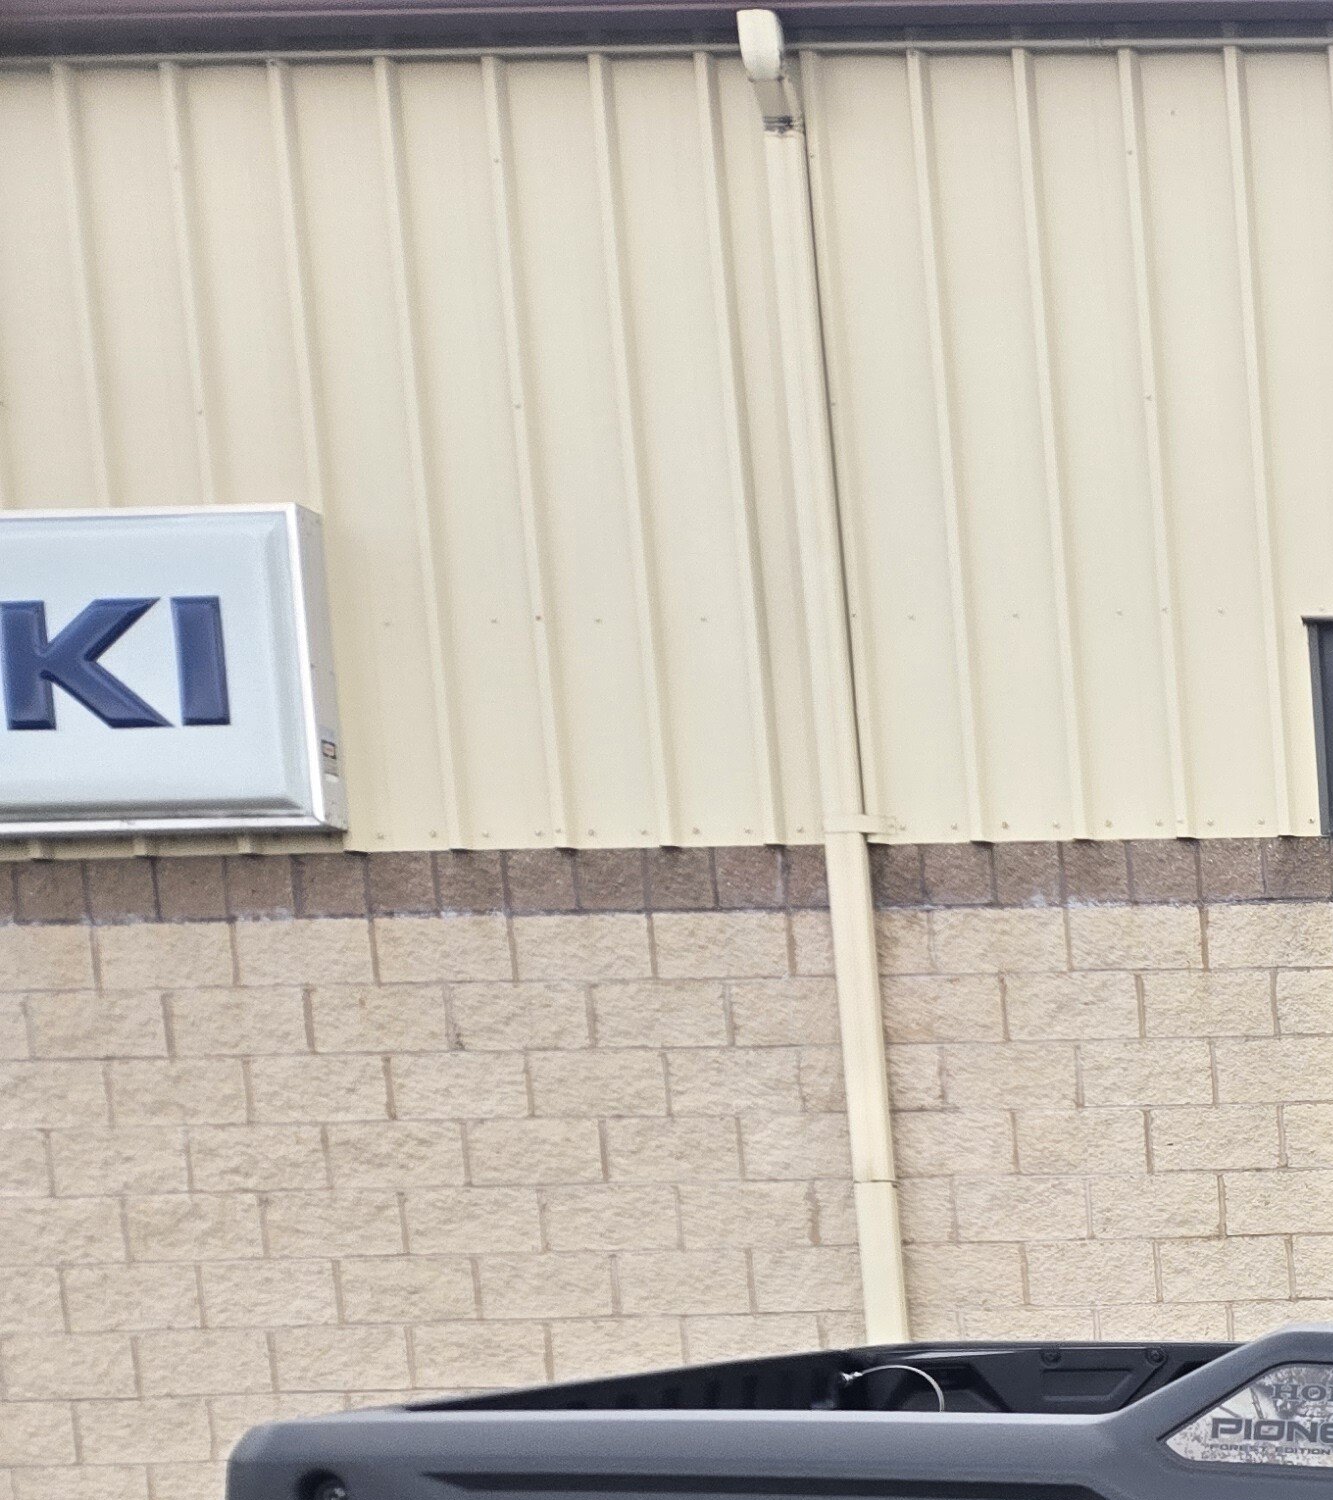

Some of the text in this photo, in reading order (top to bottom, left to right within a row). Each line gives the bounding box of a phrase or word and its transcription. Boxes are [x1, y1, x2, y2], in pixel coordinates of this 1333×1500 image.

[0, 595, 231, 731] KI
[1209, 1443, 1331, 1455] FOREST EDITION
